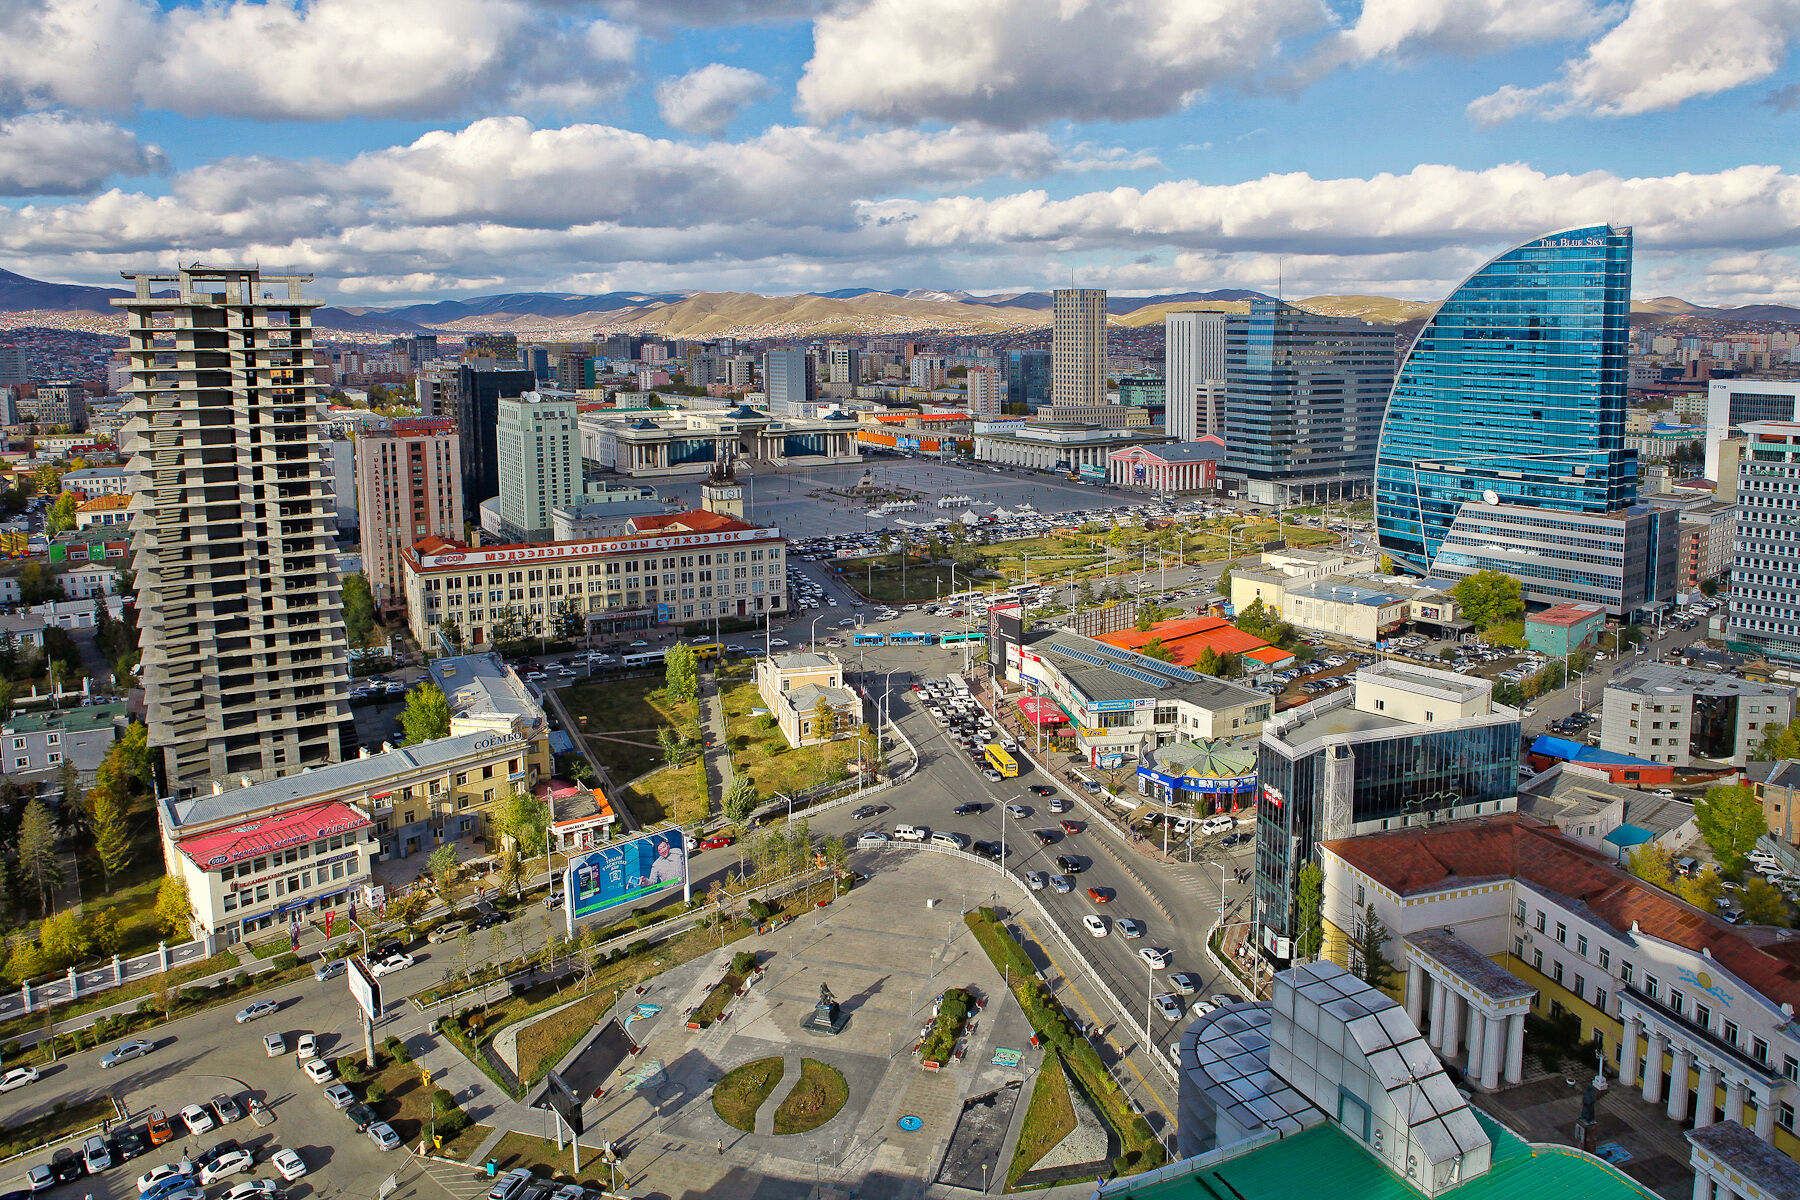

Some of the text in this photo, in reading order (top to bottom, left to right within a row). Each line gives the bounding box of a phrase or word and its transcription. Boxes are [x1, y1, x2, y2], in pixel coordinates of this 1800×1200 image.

[374, 458, 382, 520] ULAANBAATAR
[485, 548, 564, 561] МЭДЭЭЛЭЛ
[571, 540, 649, 554] ХОЛБООНЫ
[655, 535, 710, 547] СҮЛЖЭЭ
[716, 533, 741, 542] ТӨК
[1264, 783, 1283, 800] eagle
[326, 819, 366, 834] AIRLINK
